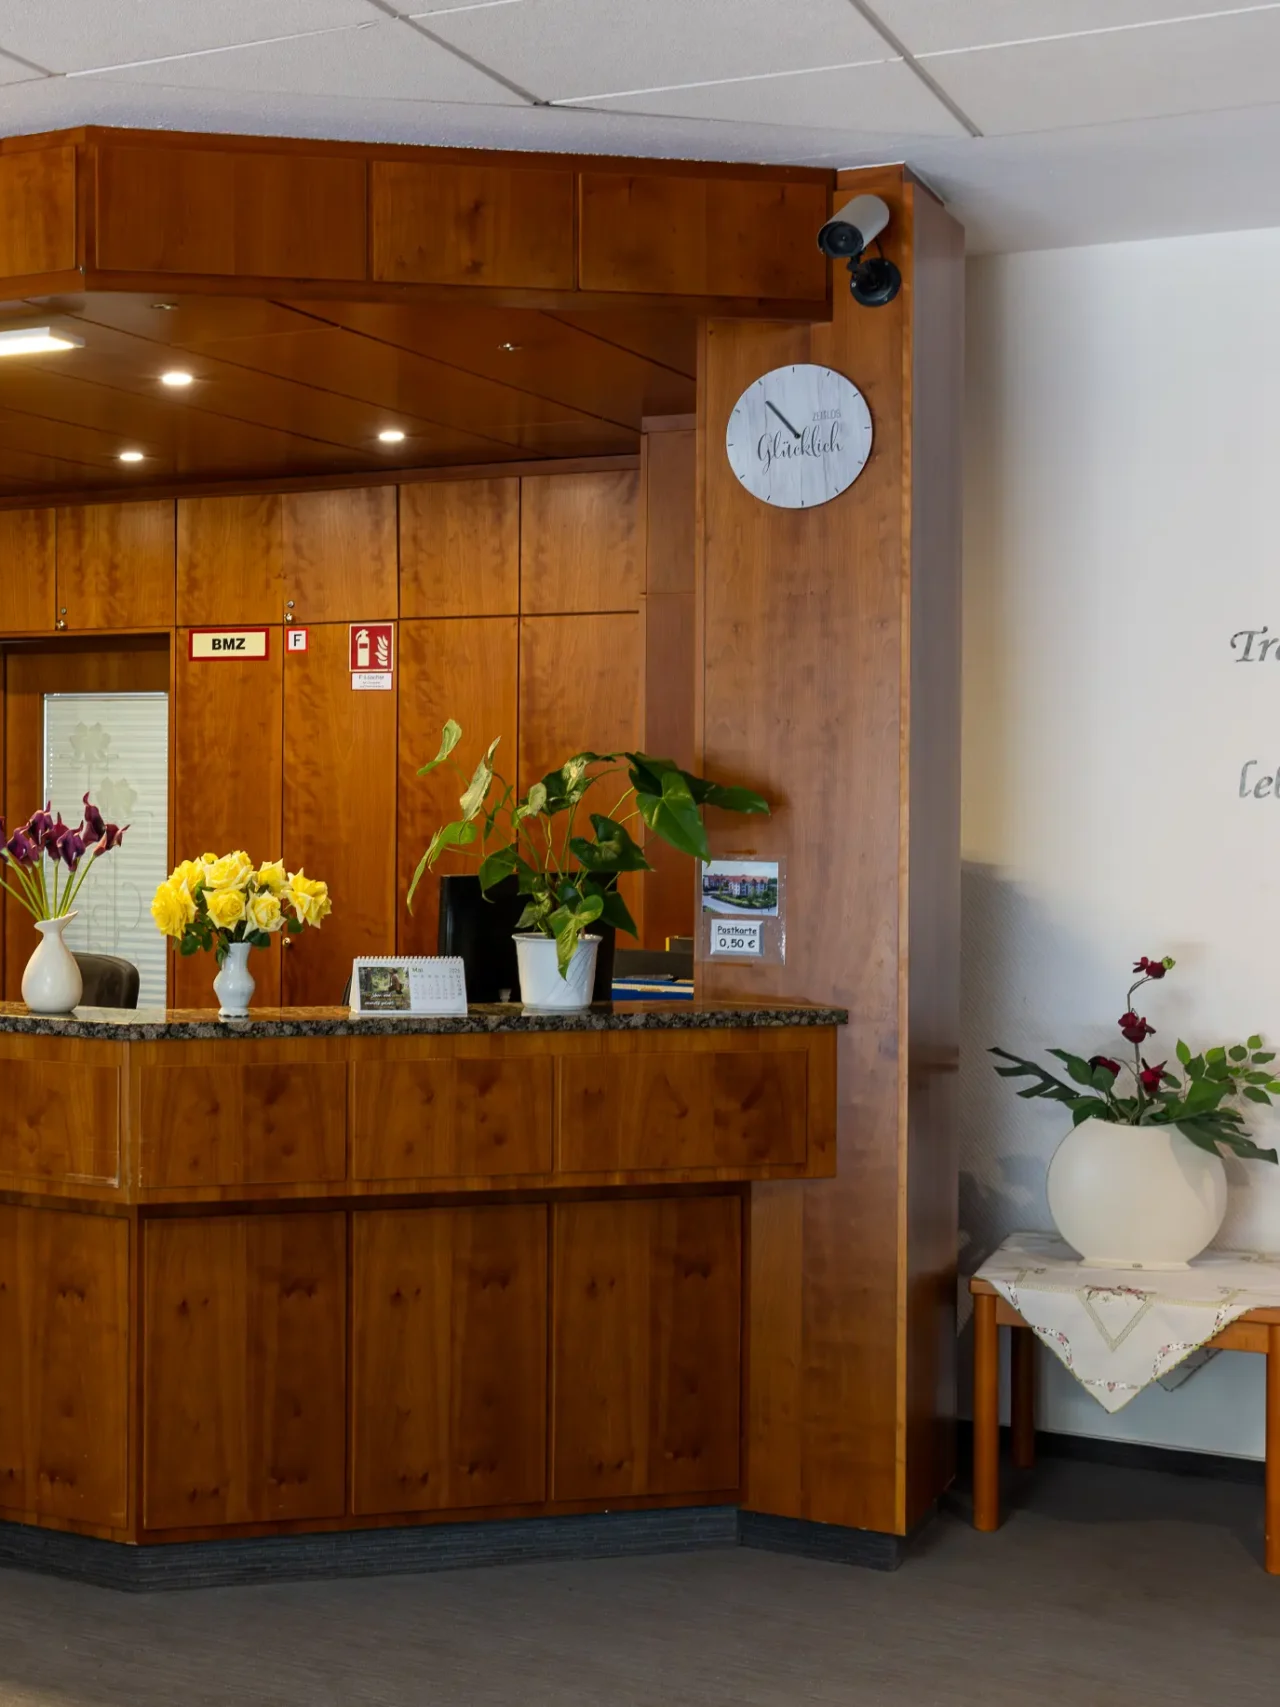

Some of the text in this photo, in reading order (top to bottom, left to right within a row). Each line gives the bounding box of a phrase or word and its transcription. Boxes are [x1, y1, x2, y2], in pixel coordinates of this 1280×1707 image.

[757, 420, 843, 475] Glücklich
[211, 638, 246, 650] BMZ
[293, 633, 302, 647] F
[717, 925, 757, 935] Postkarte
[720, 938, 756, 949] 0,50 €
